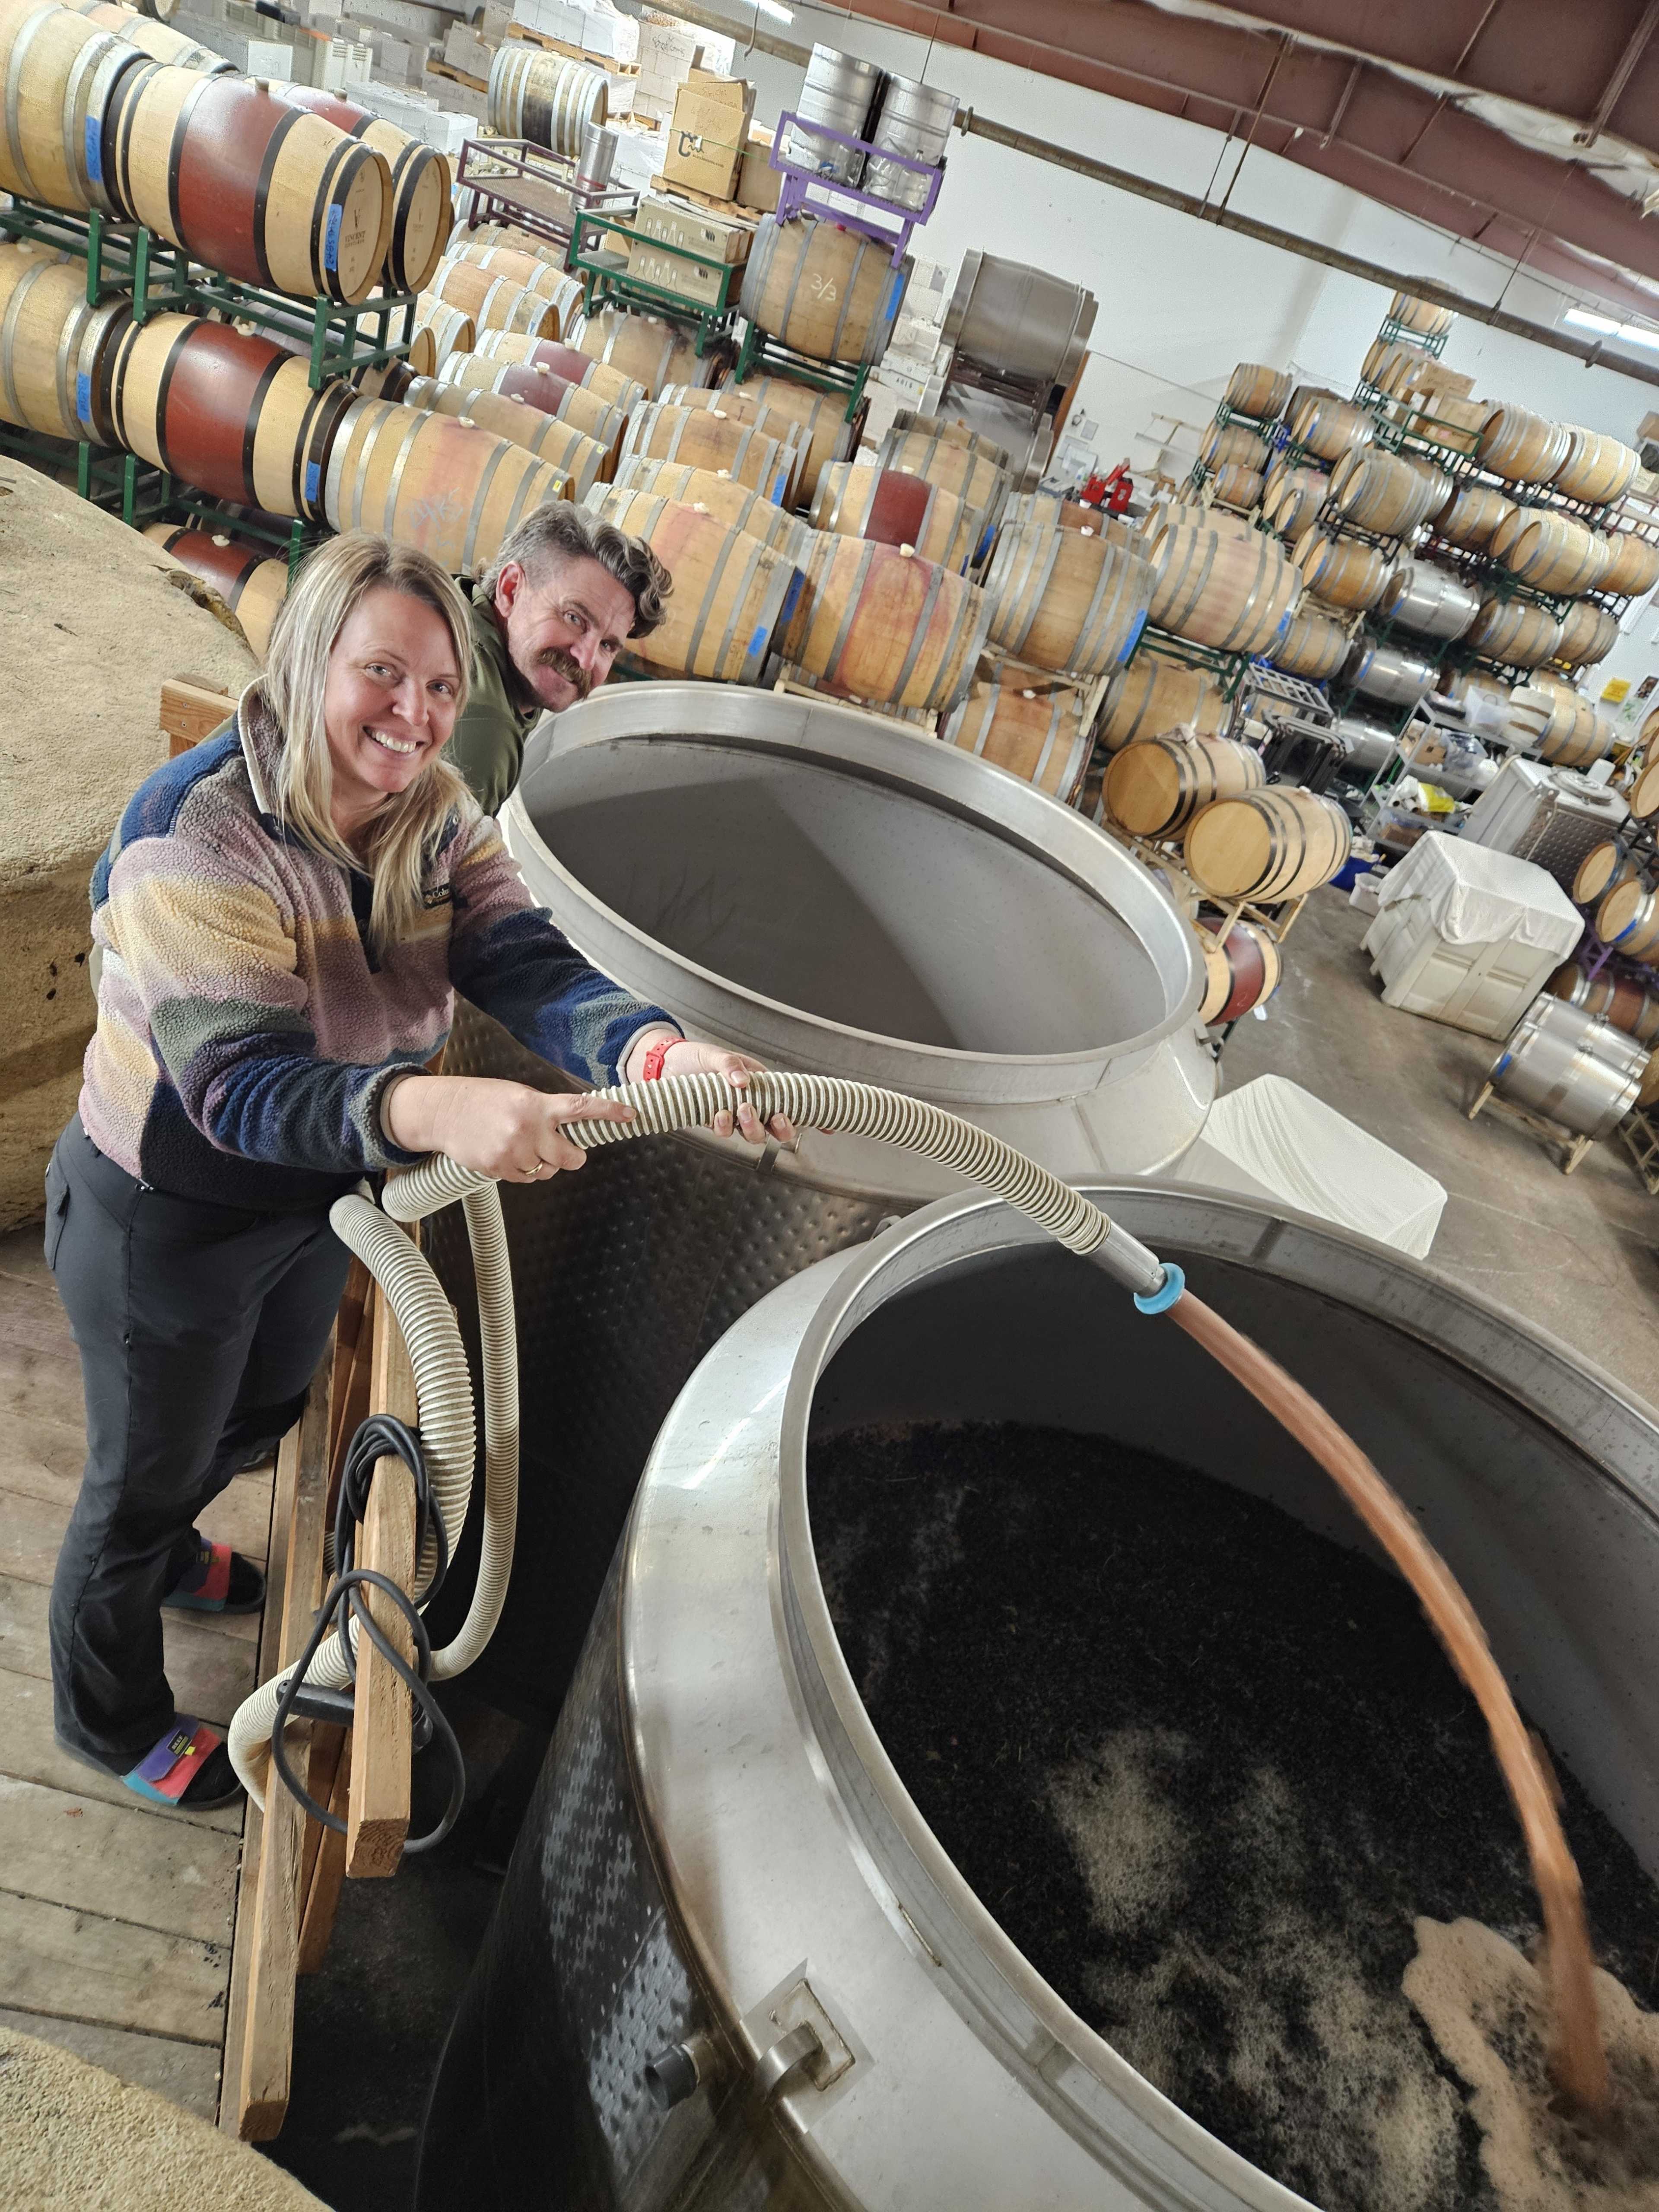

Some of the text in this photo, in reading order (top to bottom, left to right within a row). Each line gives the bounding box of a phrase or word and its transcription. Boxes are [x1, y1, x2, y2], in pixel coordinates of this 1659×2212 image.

[344, 230, 366, 242] VINCENT
[810, 273, 837, 302] 3/3
[172, 1735, 183, 1750] REEF
